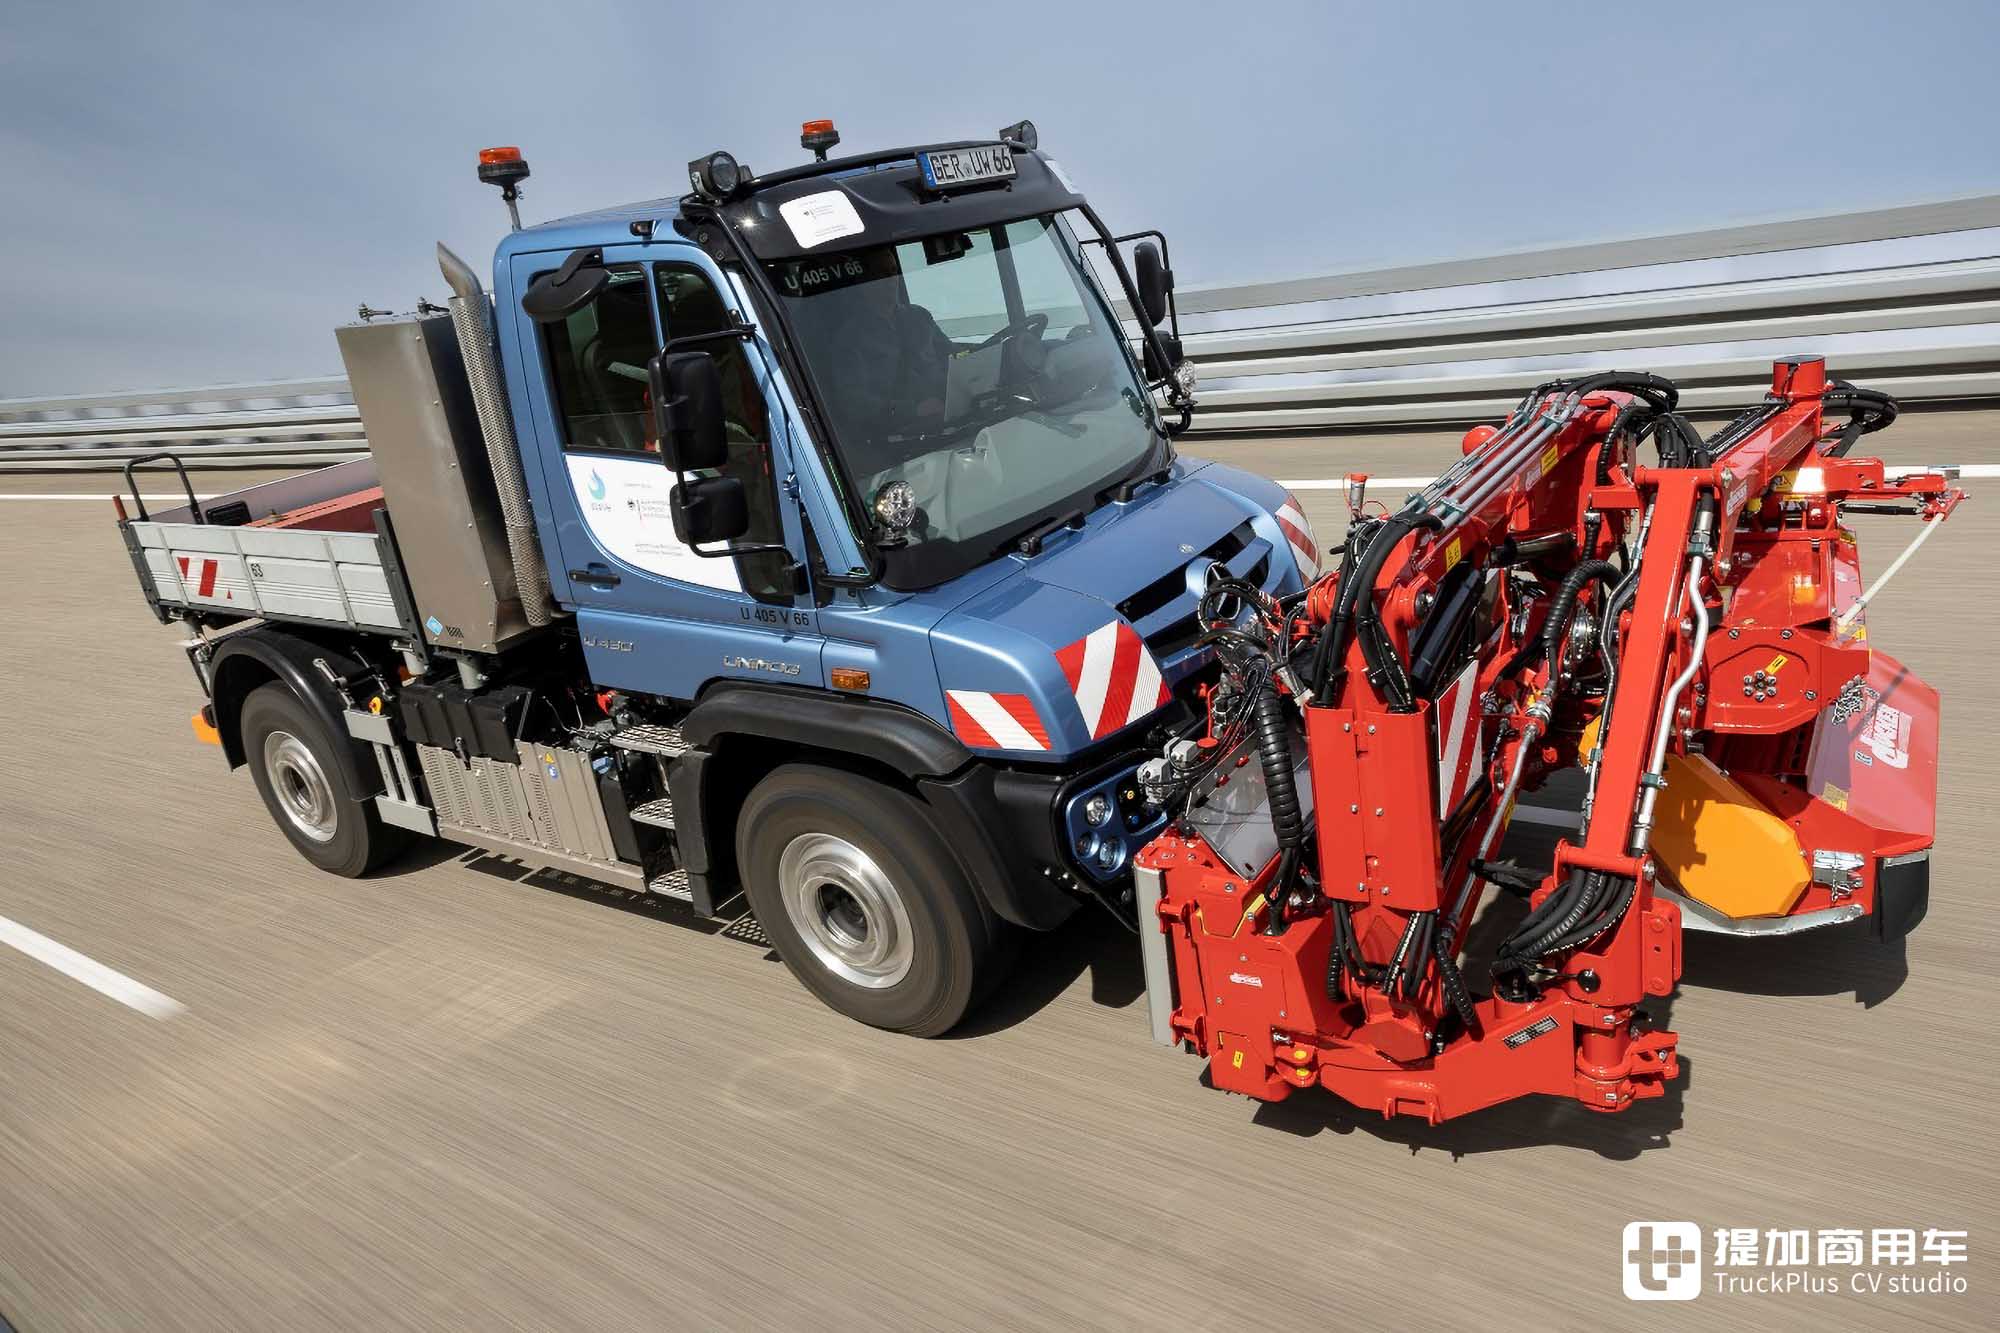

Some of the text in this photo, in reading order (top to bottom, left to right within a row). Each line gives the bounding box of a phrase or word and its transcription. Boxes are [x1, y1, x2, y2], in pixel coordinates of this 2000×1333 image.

[930, 148, 1012, 180] GER UW 66
[784, 261, 864, 289] U 405 V 66
[251, 563, 263, 577] 63
[741, 606, 810, 626] U 405 V 66
